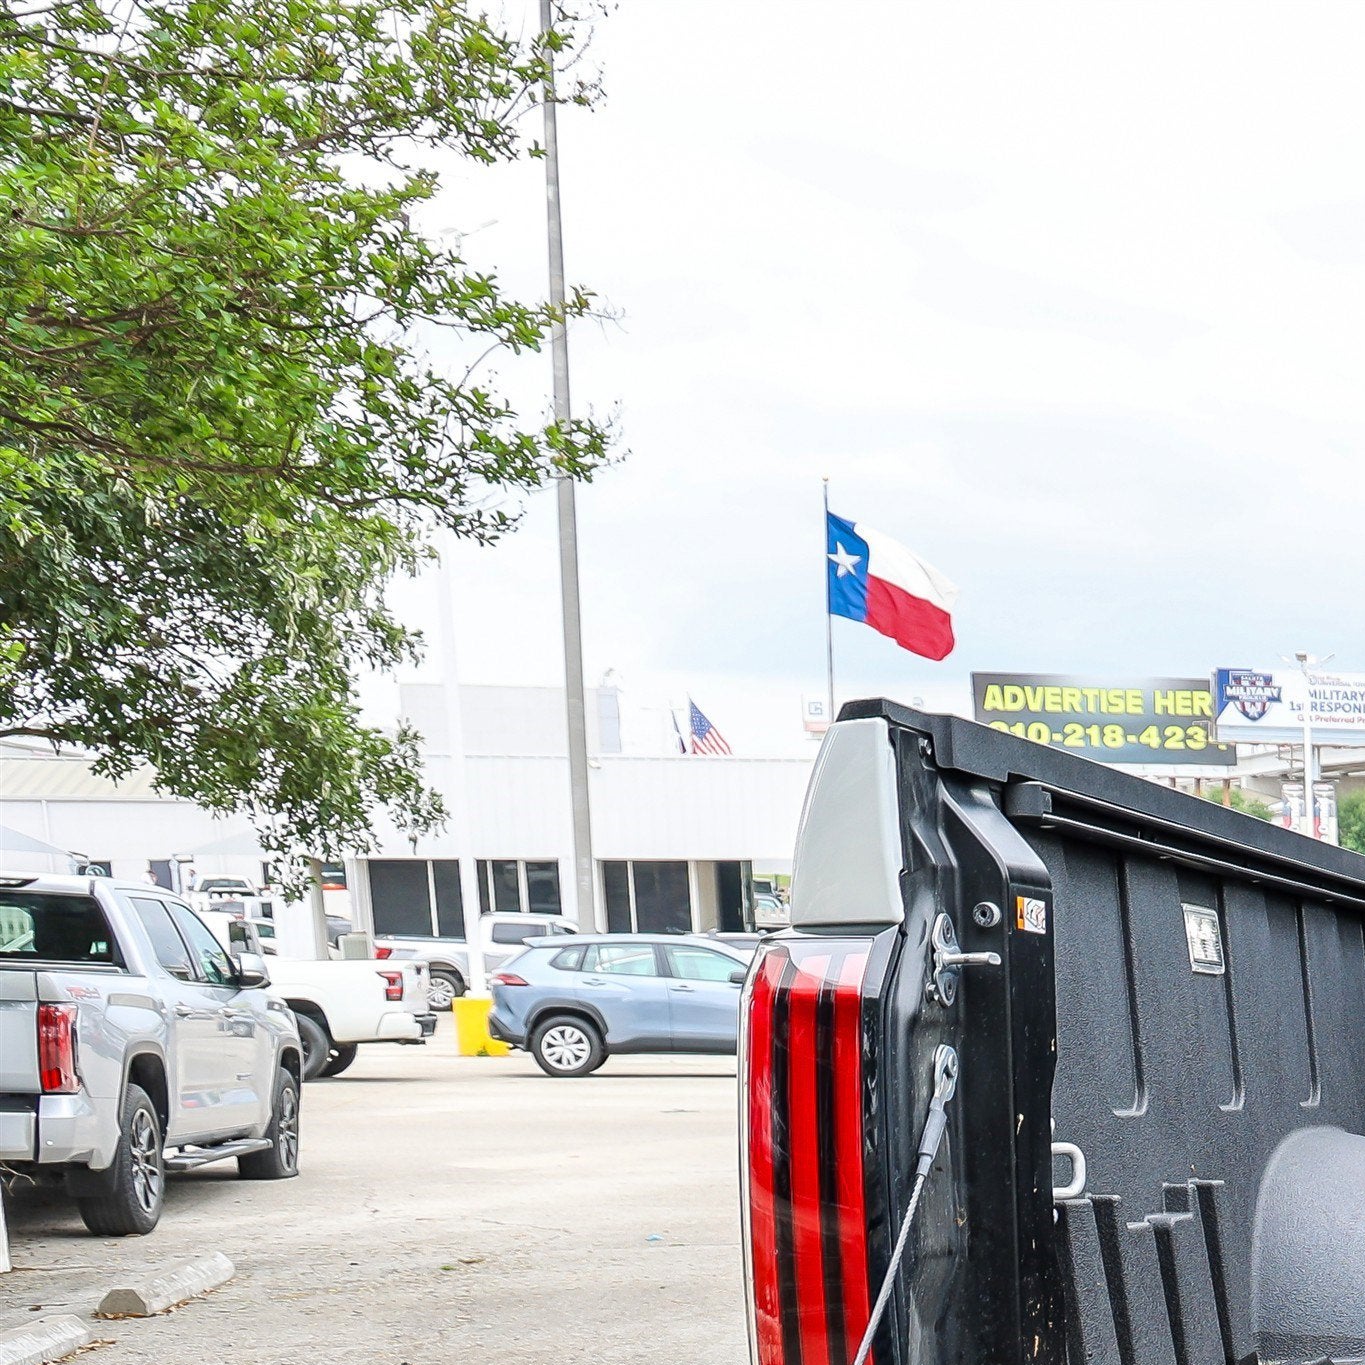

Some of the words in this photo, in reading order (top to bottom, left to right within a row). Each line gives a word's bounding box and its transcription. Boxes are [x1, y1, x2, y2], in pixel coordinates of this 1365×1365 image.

[1226, 685, 1280, 699] MILITARY
[1308, 689, 1365, 701] MILITARY
[983, 684, 1144, 715] ADVERTISE
[1297, 714, 1313, 722] Gt
[1314, 714, 1355, 723] Preferred
